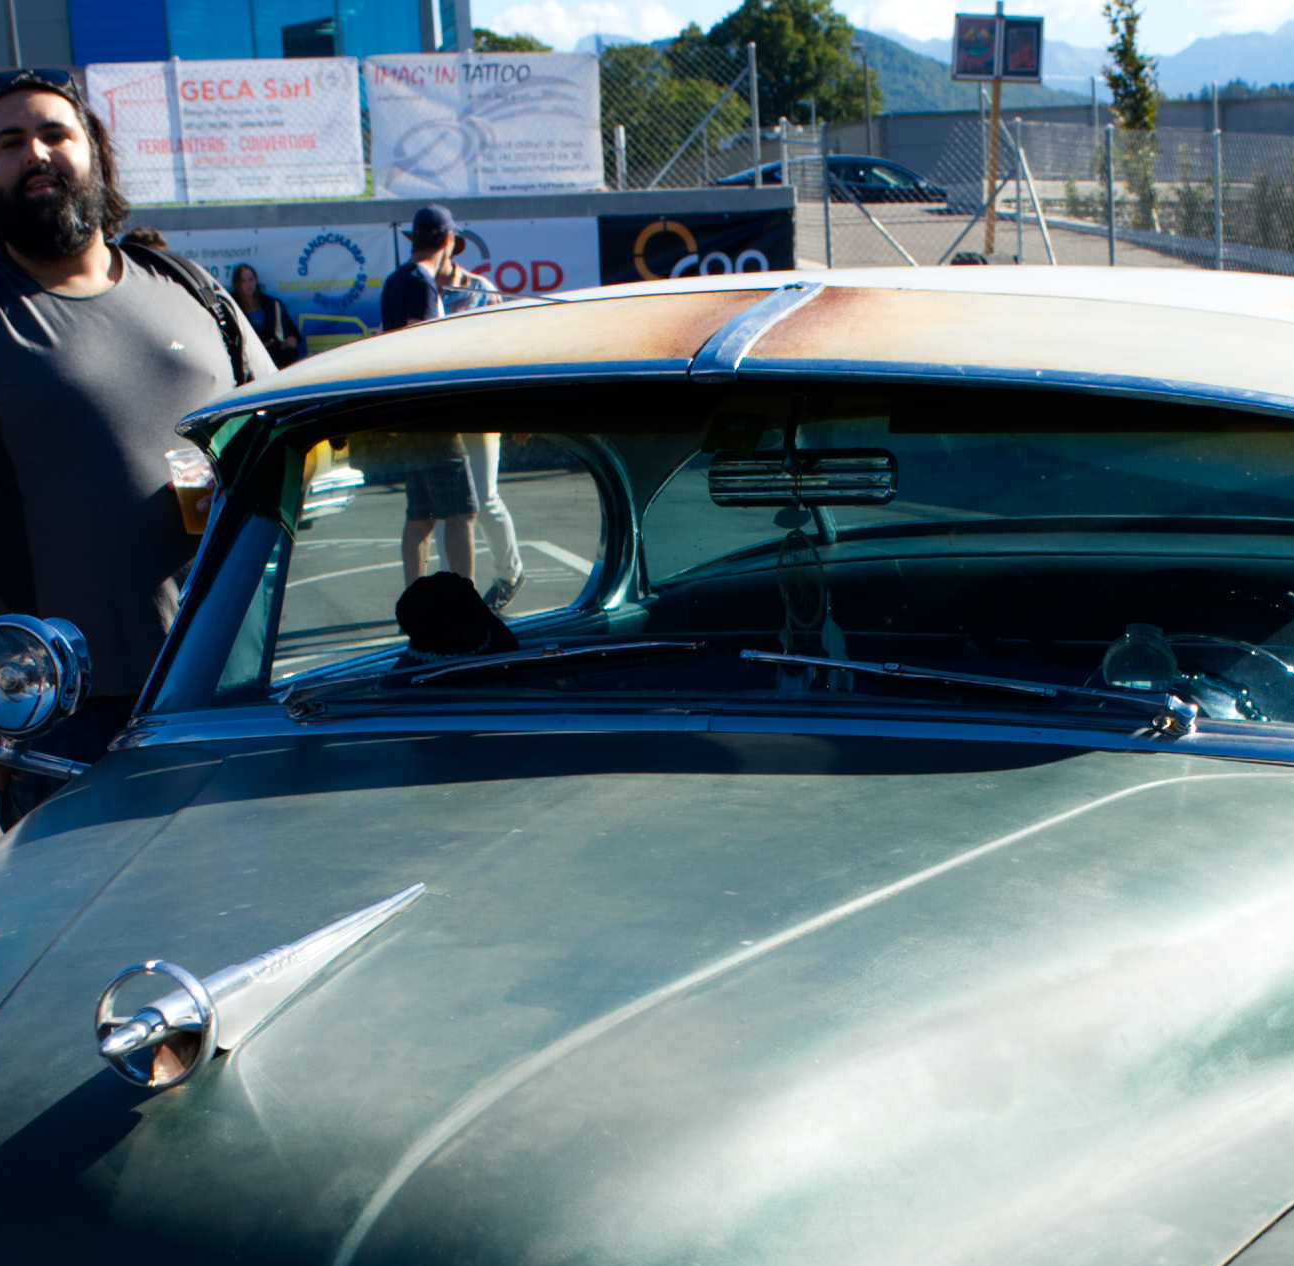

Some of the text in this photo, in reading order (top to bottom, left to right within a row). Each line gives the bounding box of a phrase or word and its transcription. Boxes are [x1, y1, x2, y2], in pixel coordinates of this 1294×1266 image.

[462, 62, 531, 84] TATTOO
[180, 77, 311, 101] GECA Sàrl
[239, 133, 319, 151] COUVERTURE
